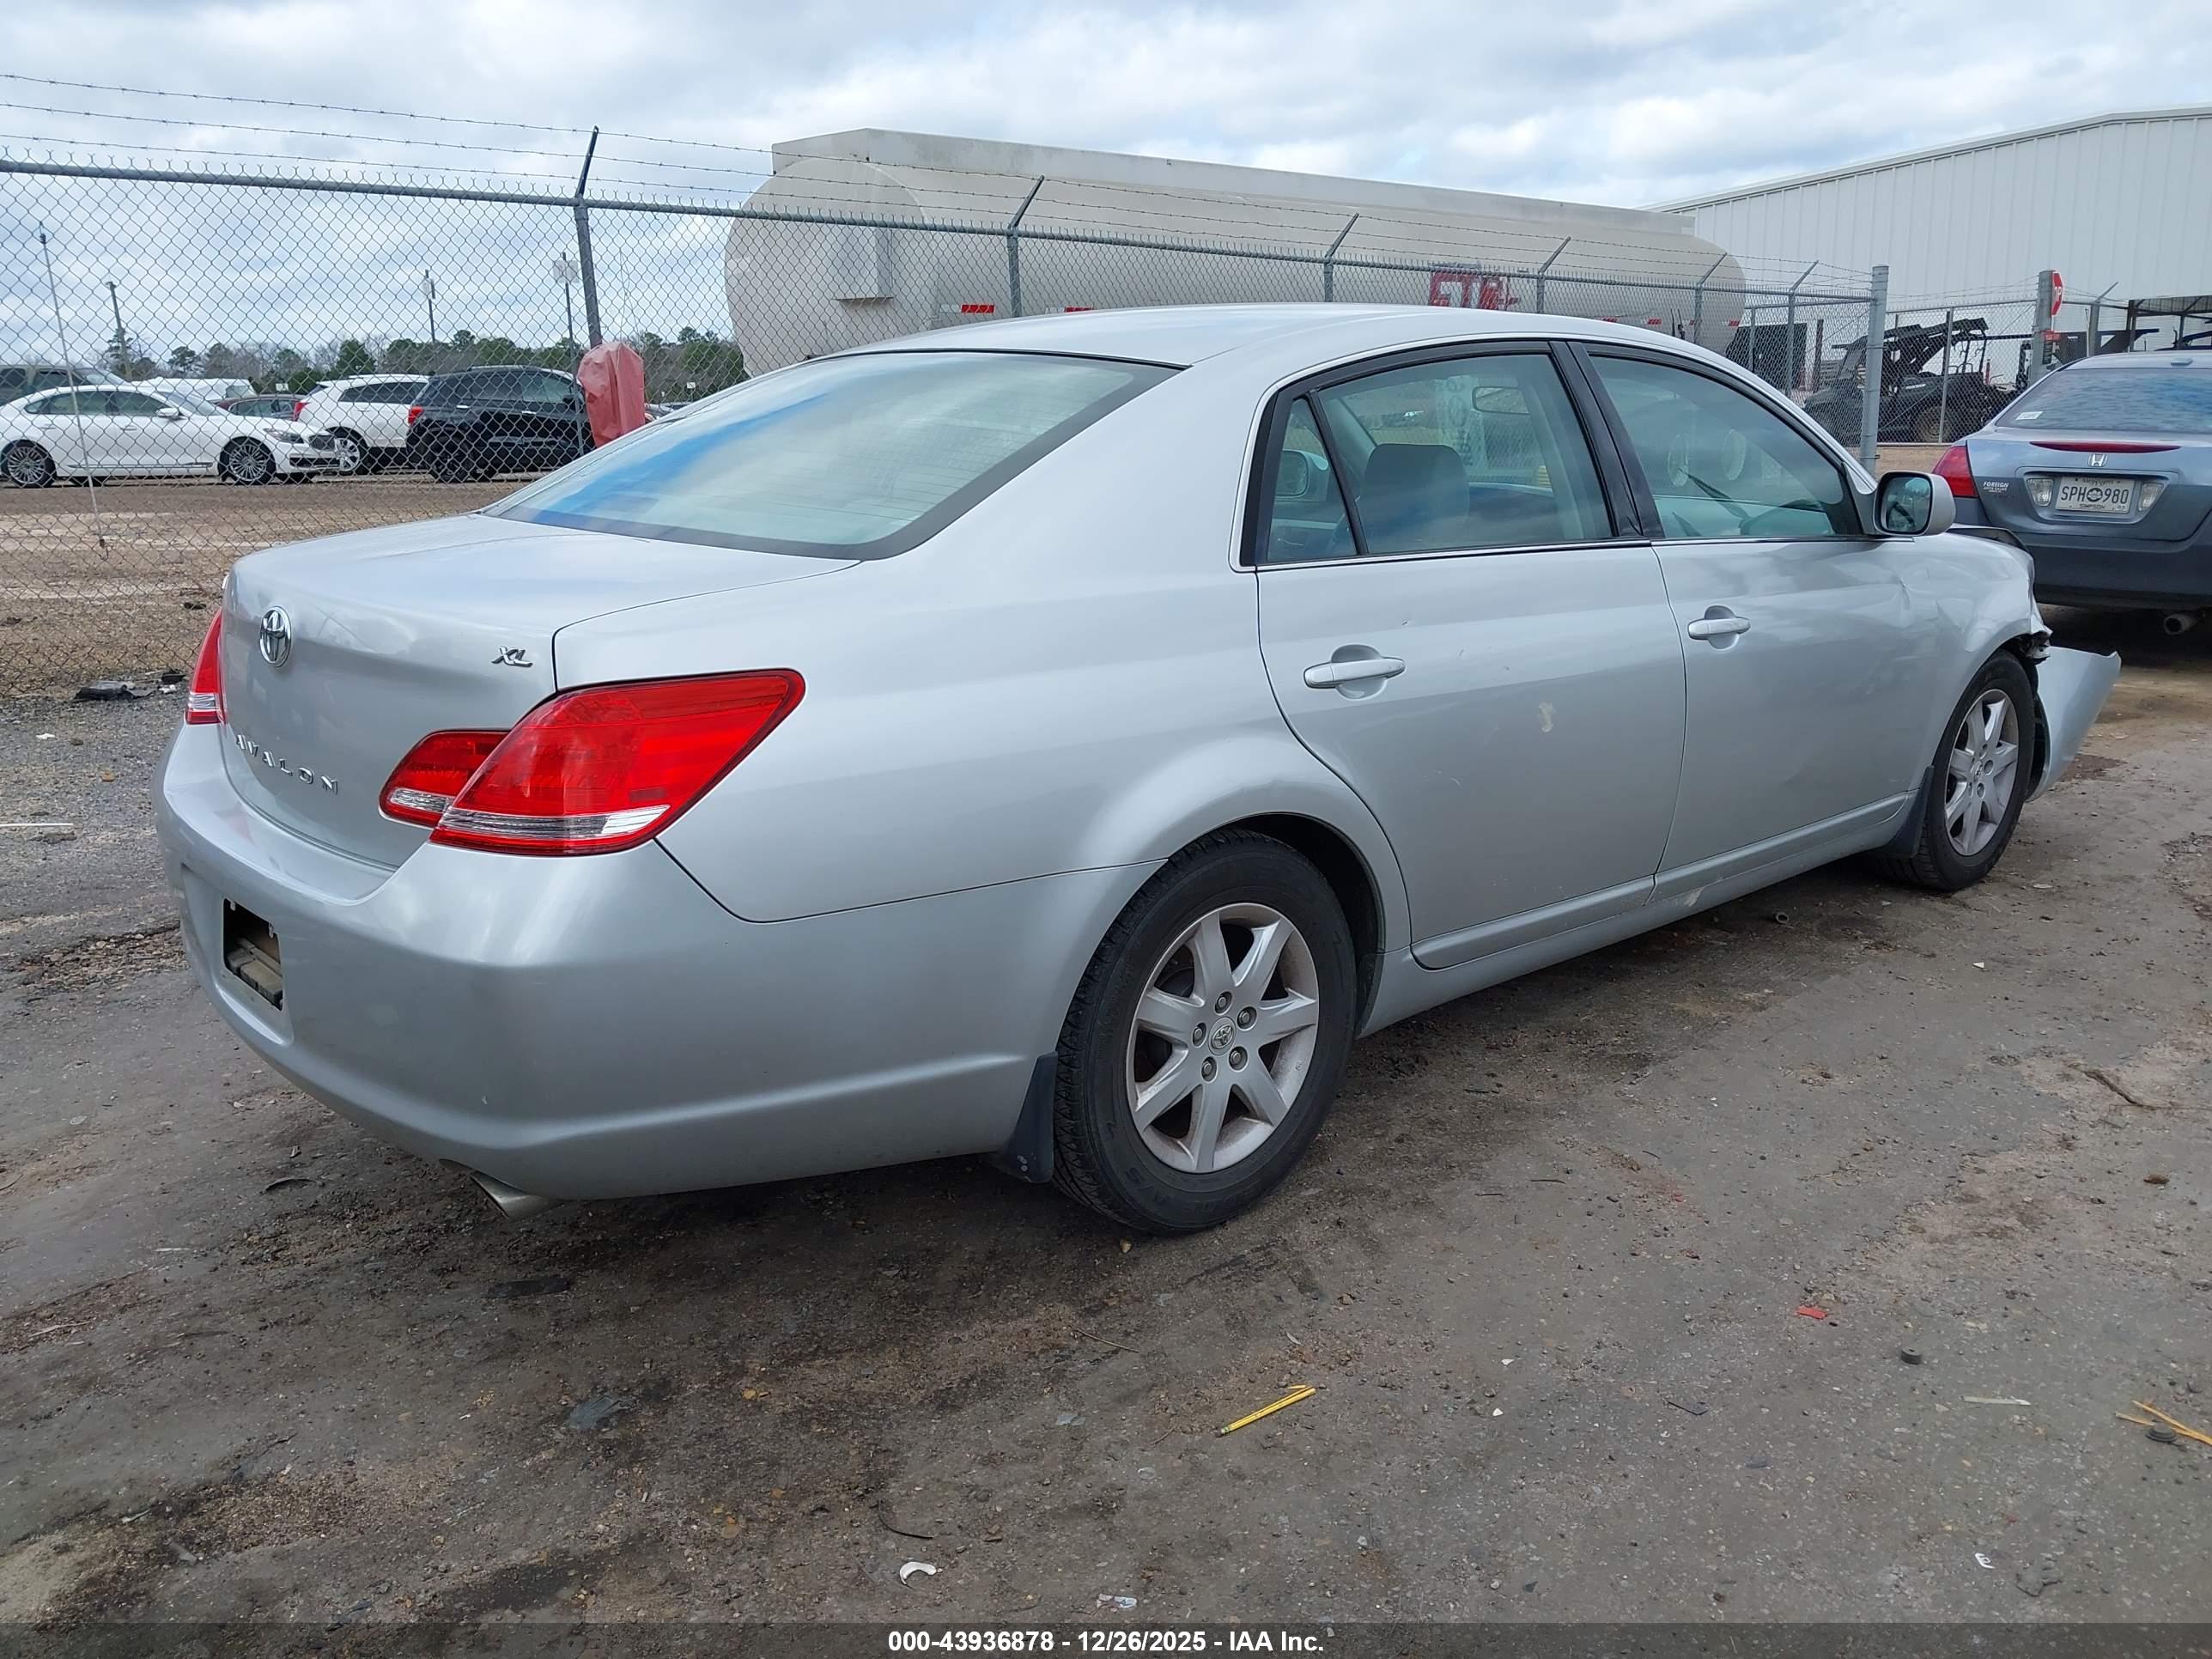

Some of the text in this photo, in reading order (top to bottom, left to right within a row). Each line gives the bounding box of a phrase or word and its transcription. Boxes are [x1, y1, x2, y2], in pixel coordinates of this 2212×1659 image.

[2060, 485, 2130, 504] SPH 980
[490, 645, 533, 668] XL
[235, 734, 338, 795] AVALON
